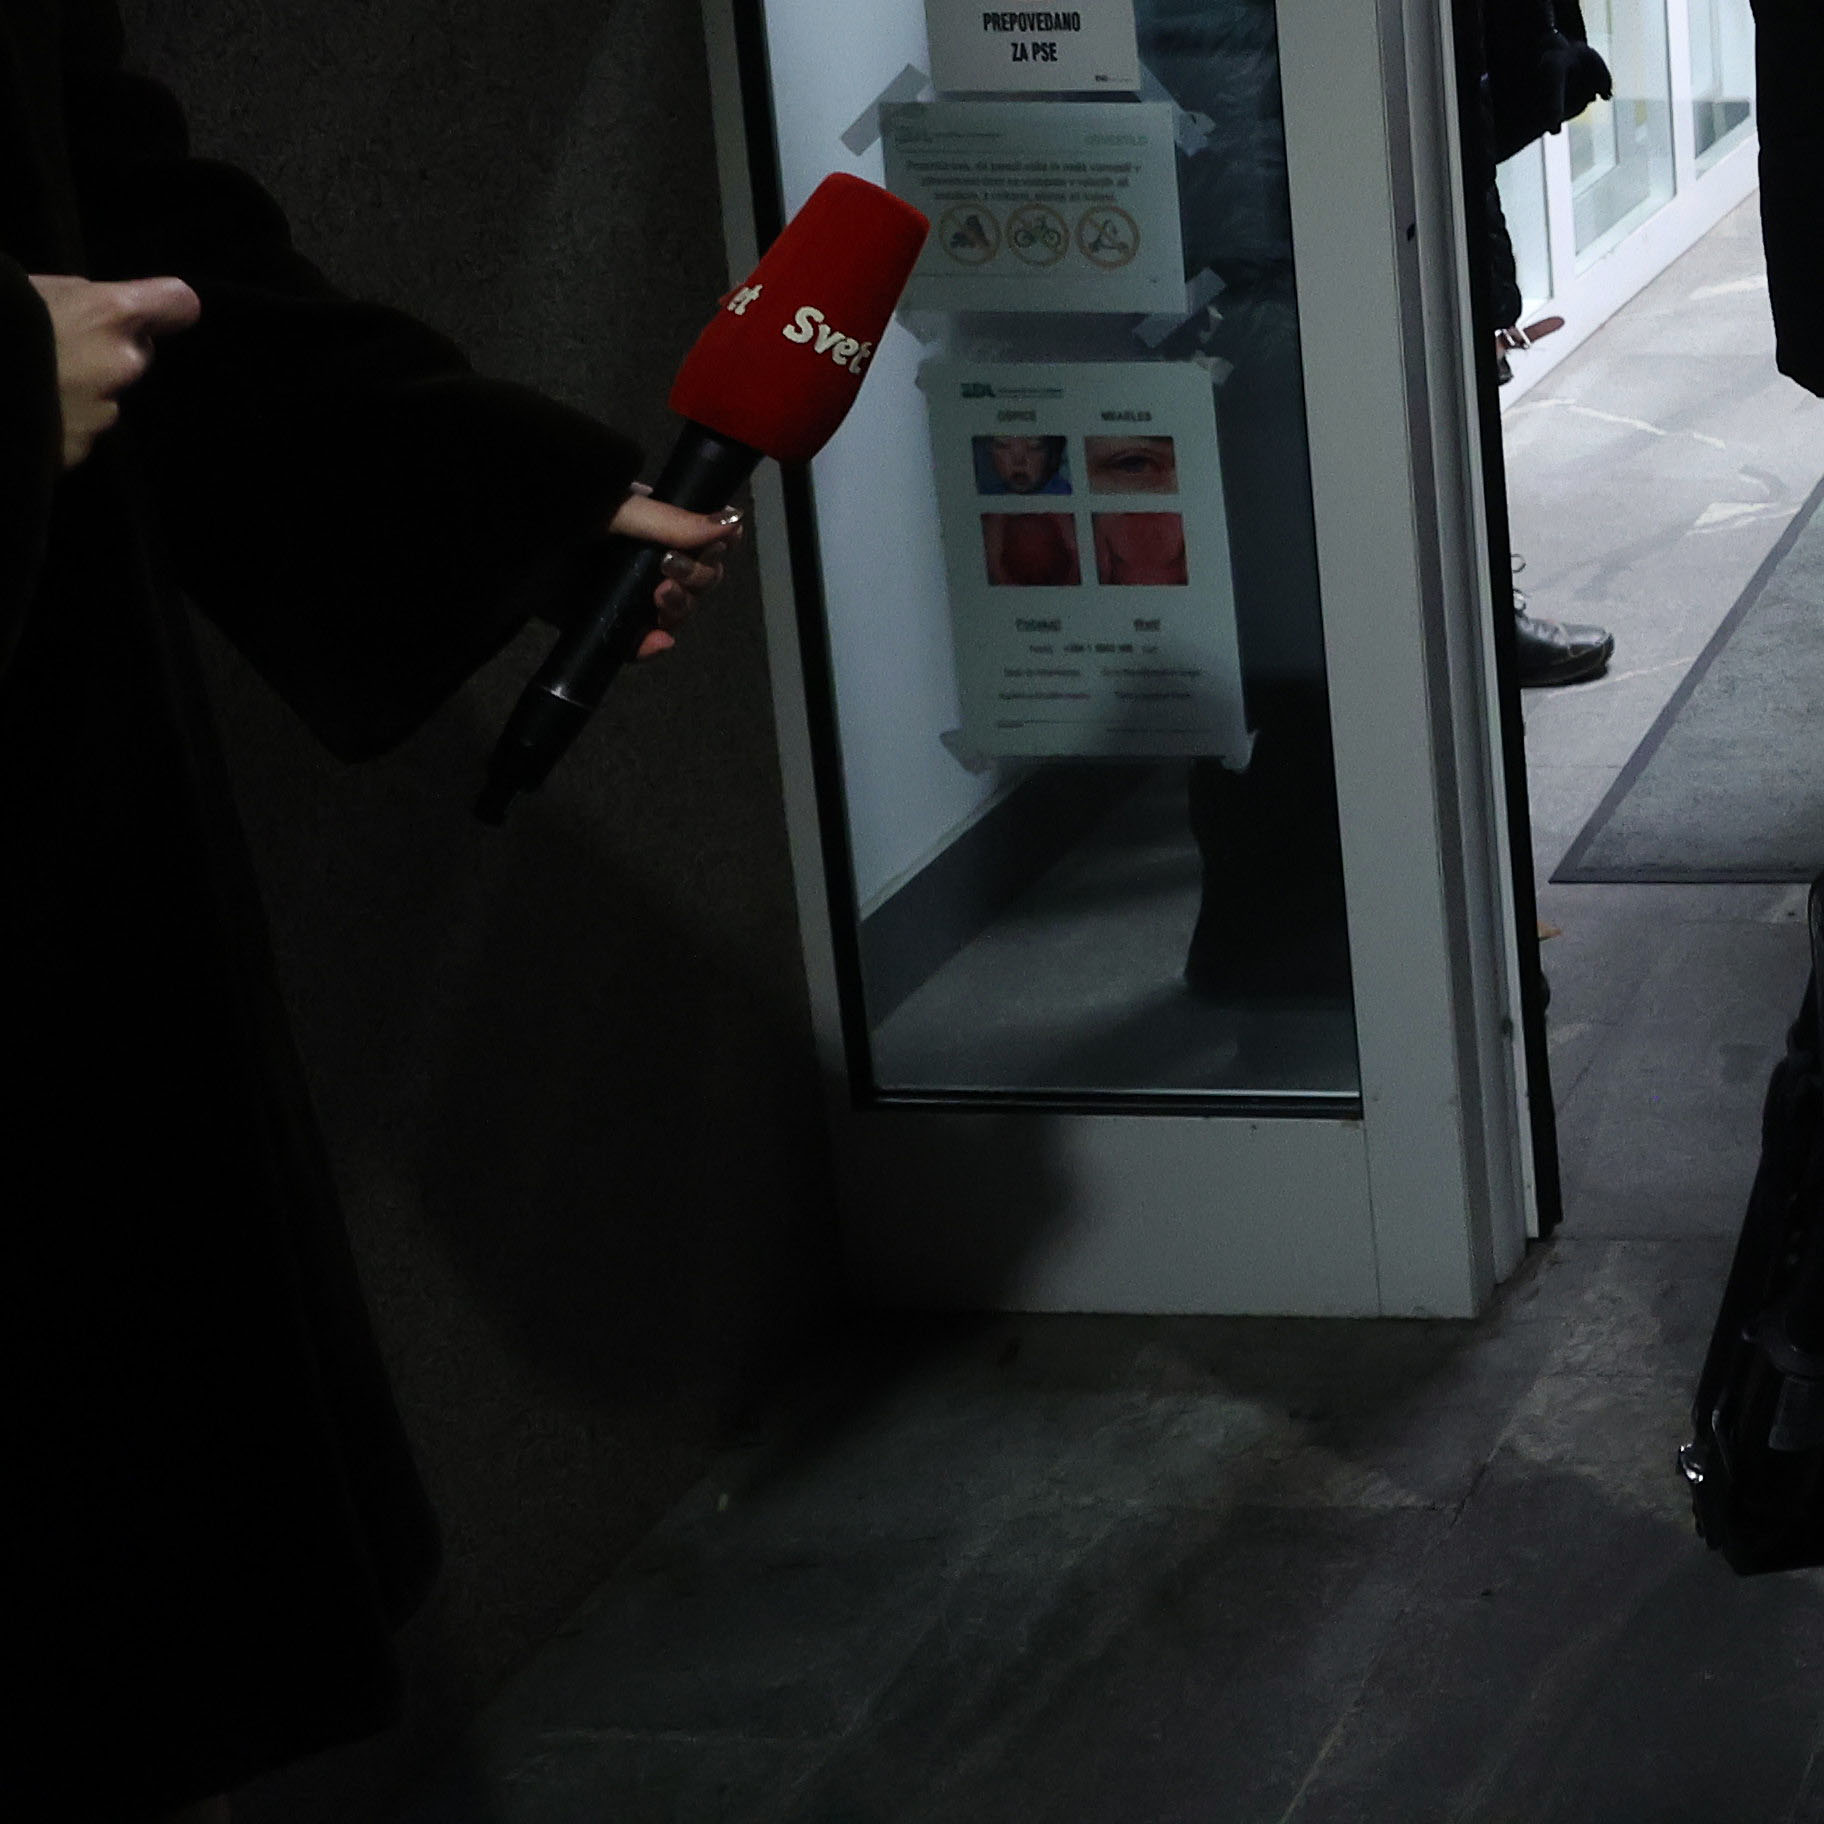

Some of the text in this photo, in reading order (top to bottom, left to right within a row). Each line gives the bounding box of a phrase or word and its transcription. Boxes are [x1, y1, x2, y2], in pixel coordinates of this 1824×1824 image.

[983, 12, 1081, 31] PREPOVEDANO
[1011, 42, 1058, 62] ZA PSE
[782, 306, 872, 374] Svet
